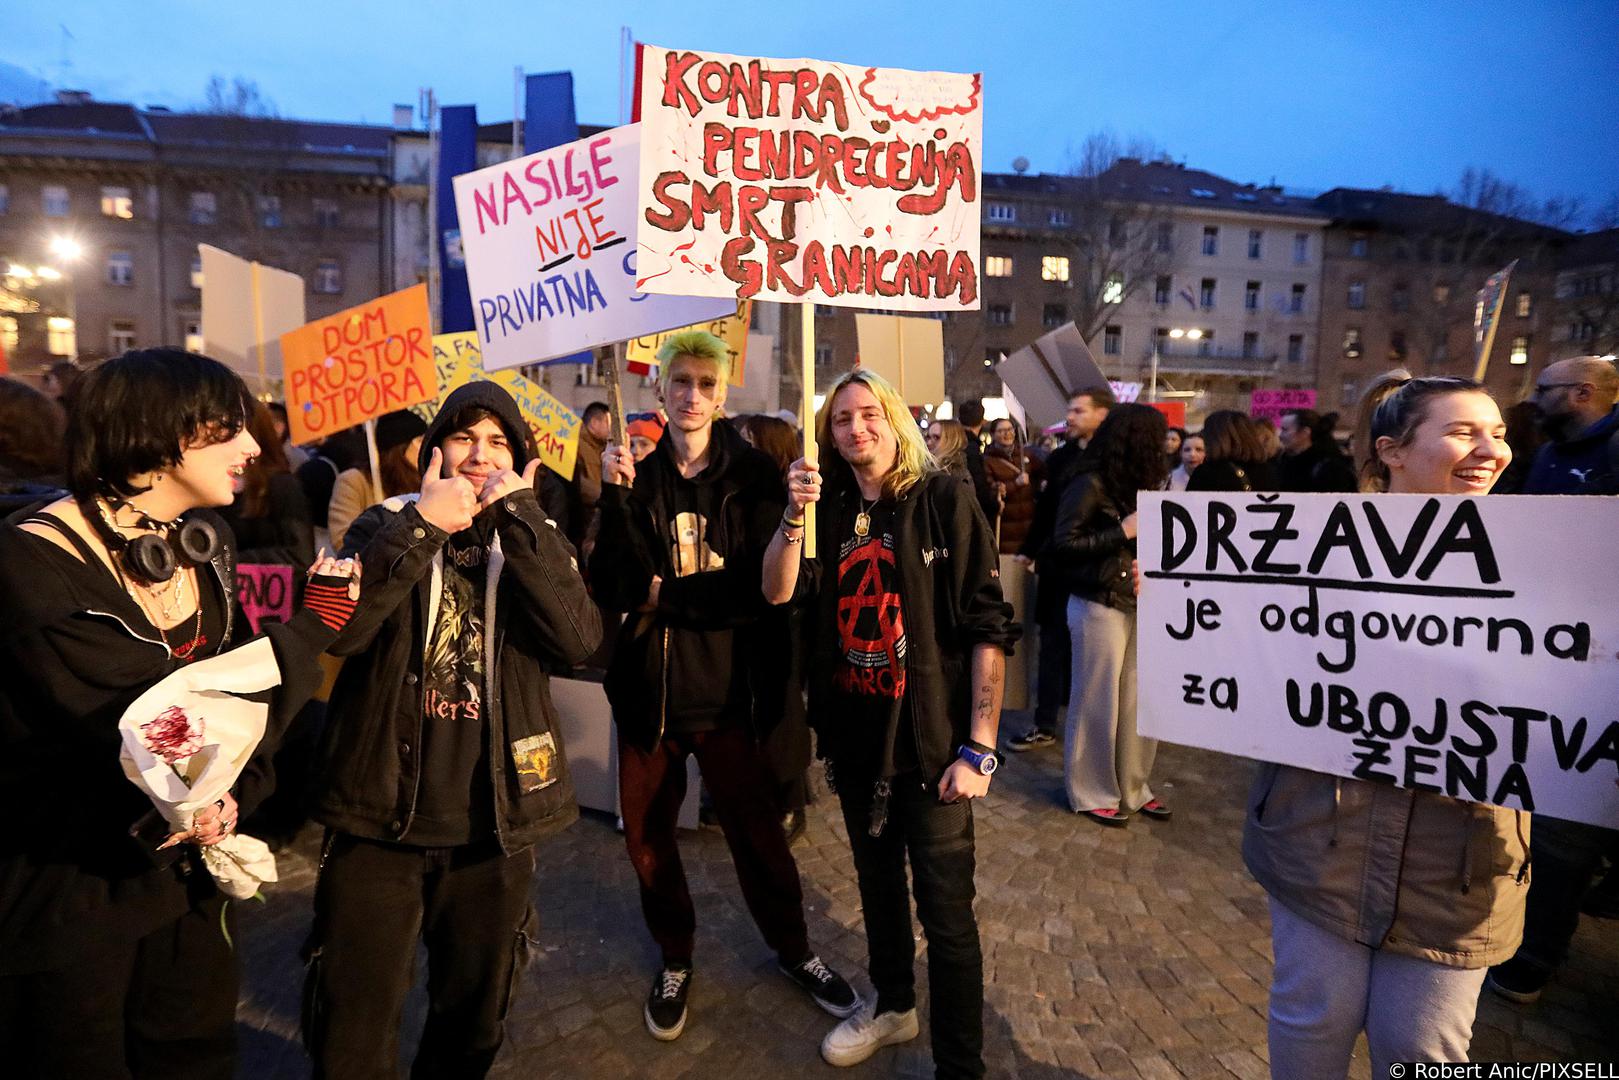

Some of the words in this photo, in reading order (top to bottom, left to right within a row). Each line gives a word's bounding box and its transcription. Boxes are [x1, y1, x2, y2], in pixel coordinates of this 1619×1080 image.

[662, 51, 849, 132] KONTRA
[535, 198, 617, 261] NIJE
[645, 170, 814, 242] SMRT
[480, 269, 608, 343] PRIVATNA
[721, 236, 977, 305] GRANICAMA
[291, 327, 429, 406] PROSTOR
[323, 307, 388, 356] DOM
[303, 367, 426, 432] OTPORA
[1160, 494, 1501, 584] DRŽAVA
[1165, 581, 1222, 640] je
[1259, 586, 1591, 674] odgovorna
[1182, 673, 1239, 713] za
[1352, 726, 1536, 812] ŽENA
